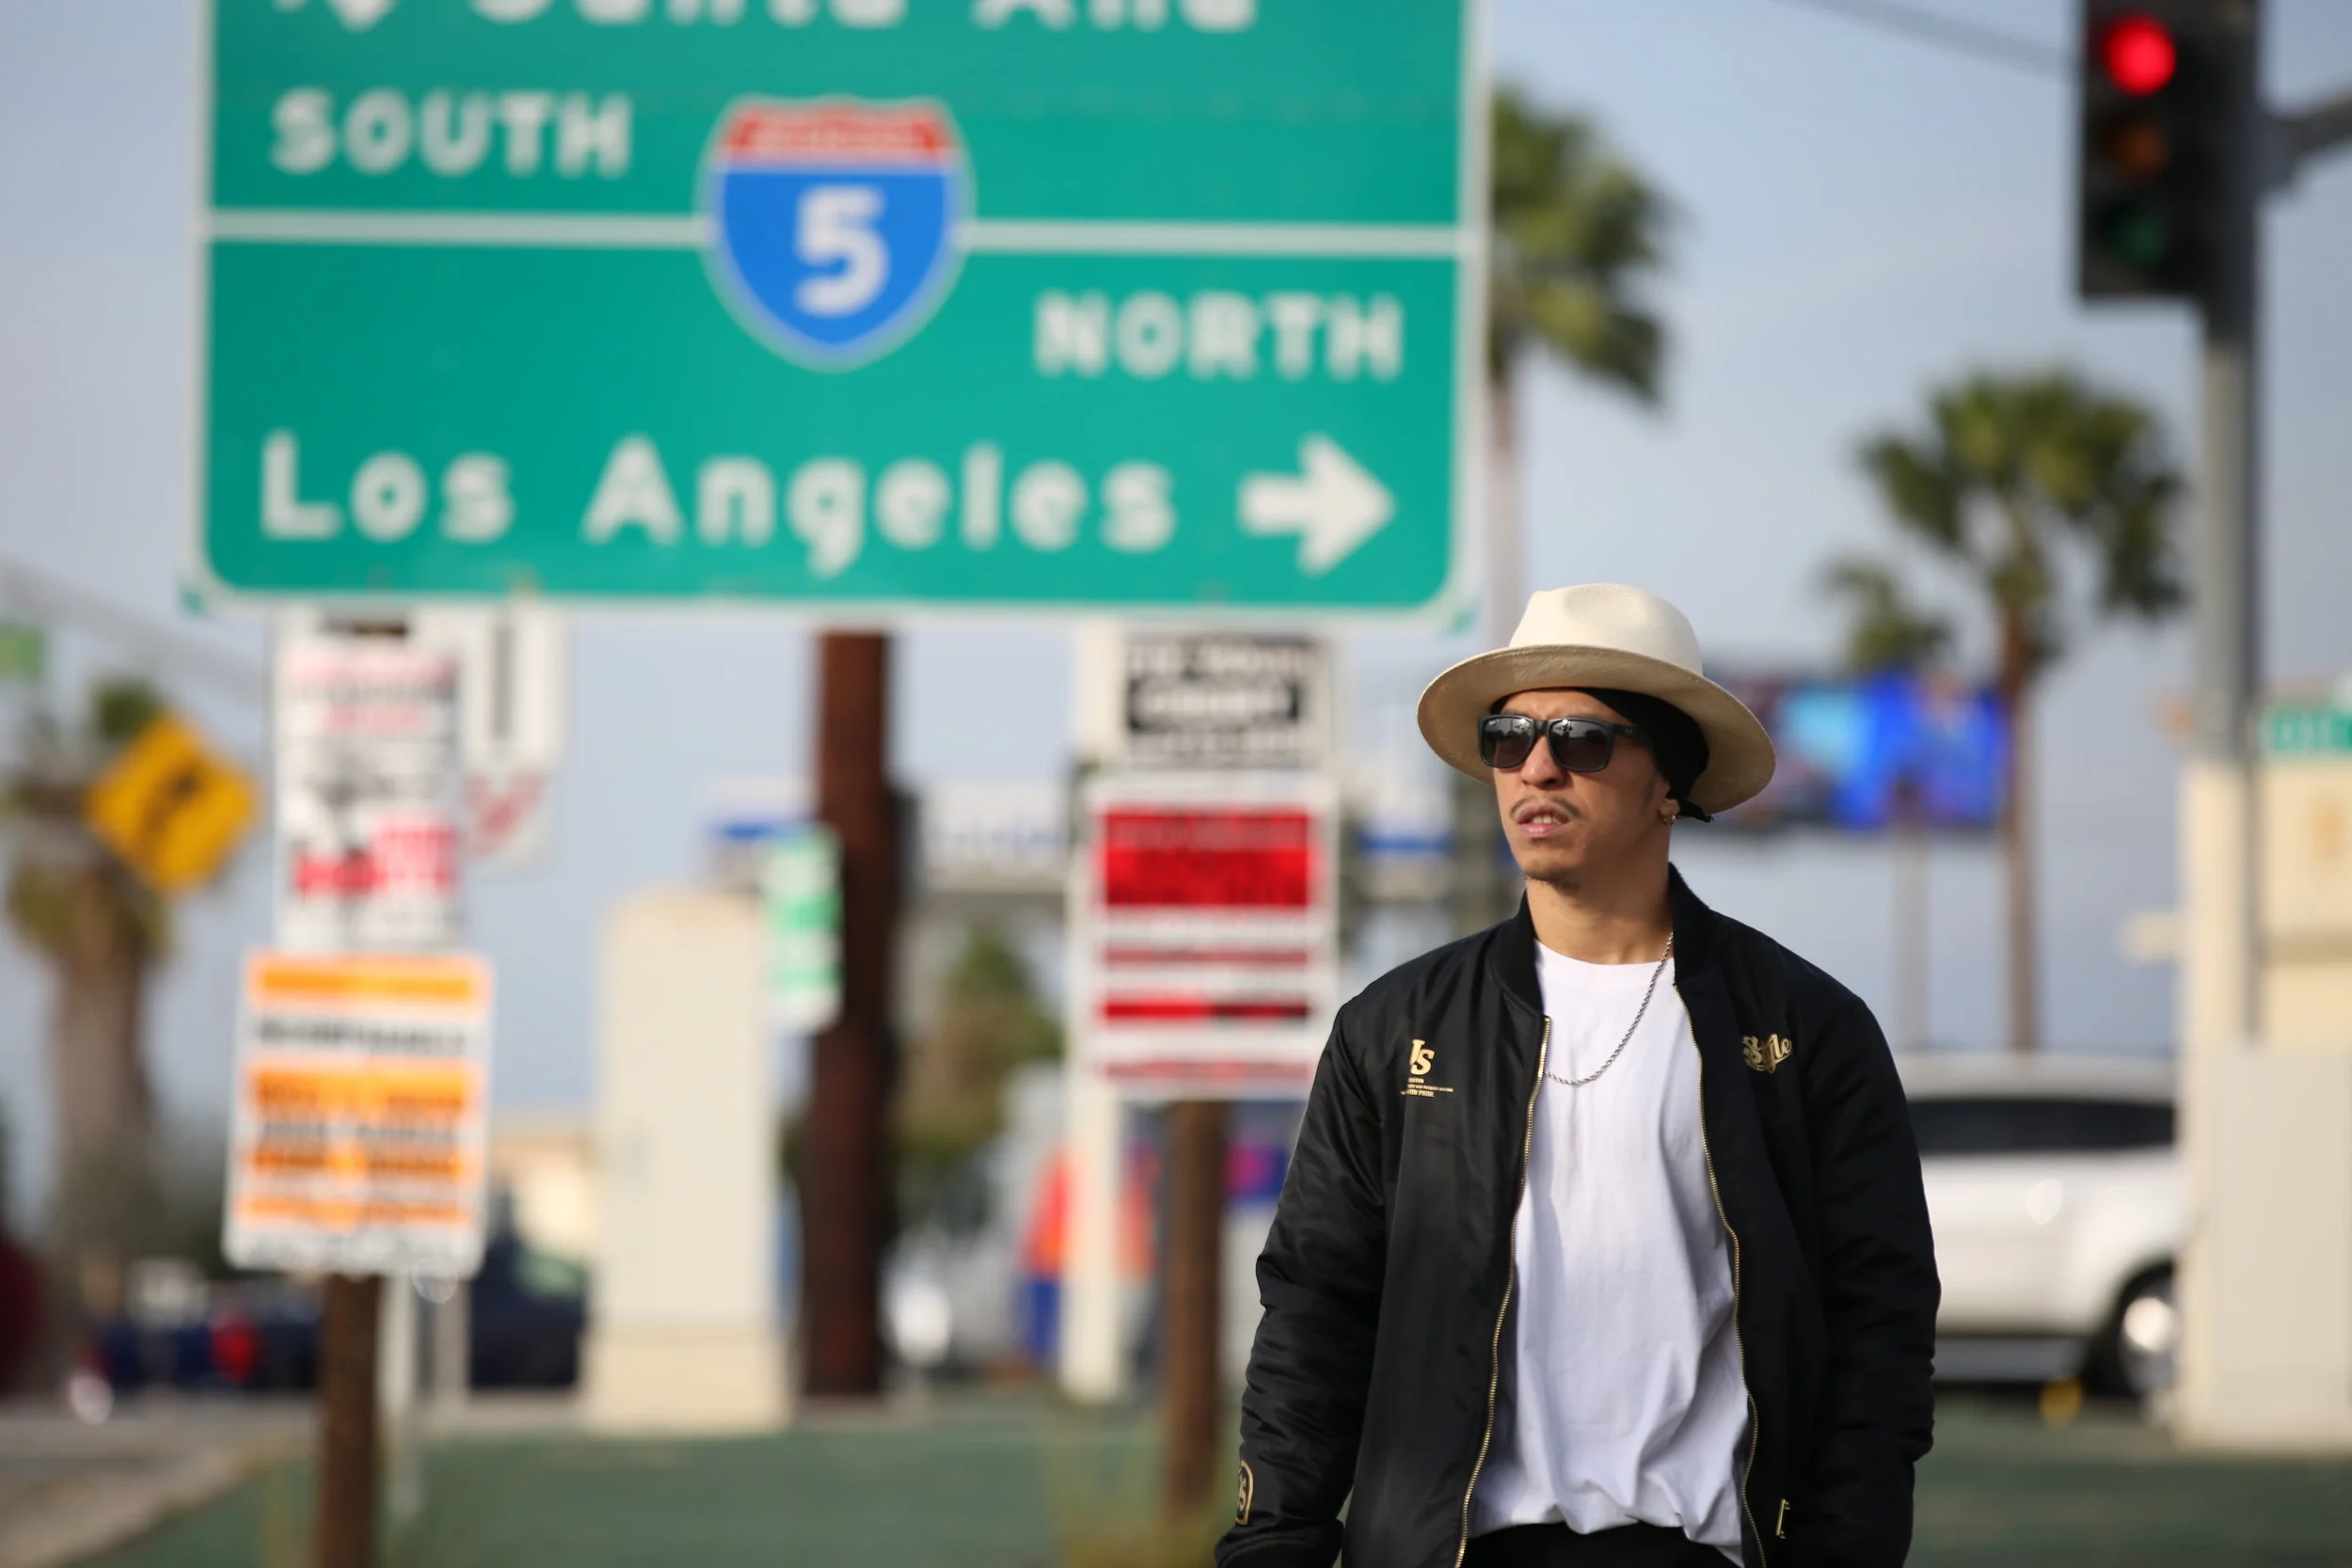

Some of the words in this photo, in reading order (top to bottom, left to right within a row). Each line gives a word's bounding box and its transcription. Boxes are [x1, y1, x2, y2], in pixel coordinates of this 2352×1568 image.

[274, 88, 632, 176] SOUTH
[794, 184, 890, 318] 5
[1035, 291, 1403, 379] NORTH
[262, 432, 514, 543] Los
[582, 436, 1177, 578] Angeles
